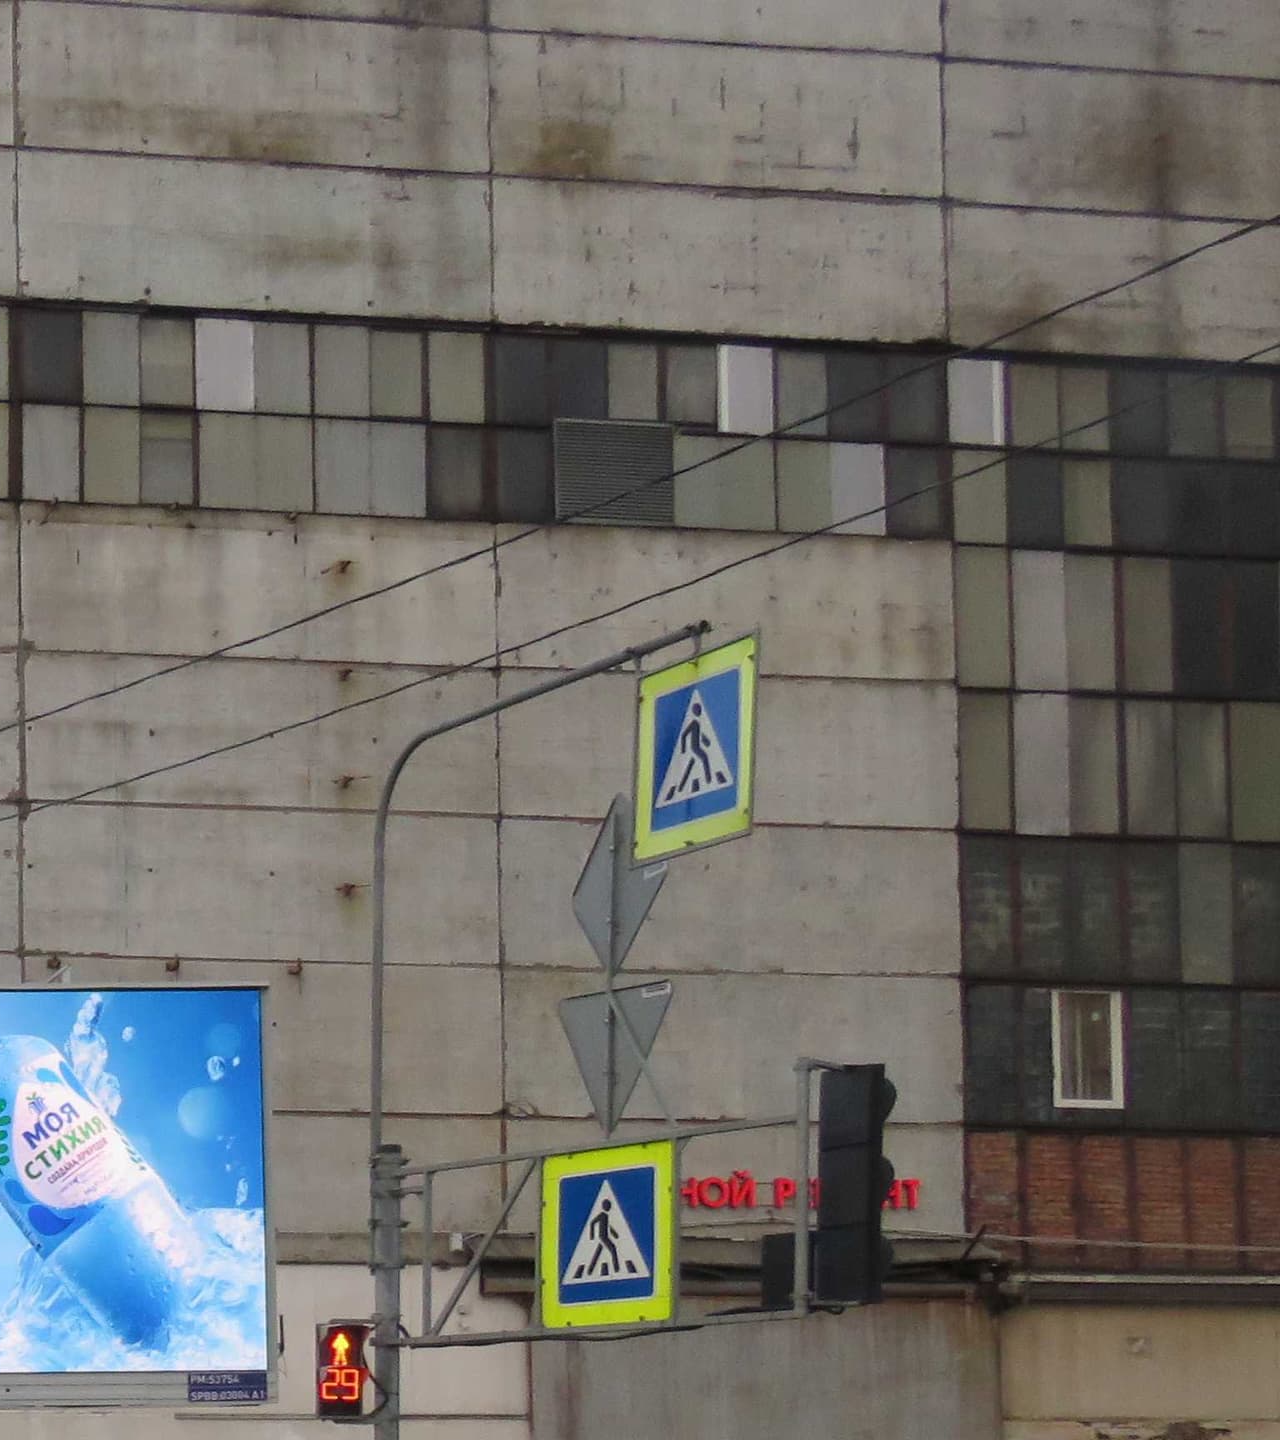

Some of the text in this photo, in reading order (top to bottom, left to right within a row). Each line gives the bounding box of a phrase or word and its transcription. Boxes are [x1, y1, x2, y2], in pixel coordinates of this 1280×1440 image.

[22, 1102, 80, 1150] МОЯ
[24, 1116, 107, 1180] СТИХИЯ
[322, 1368, 359, 1399] 29
